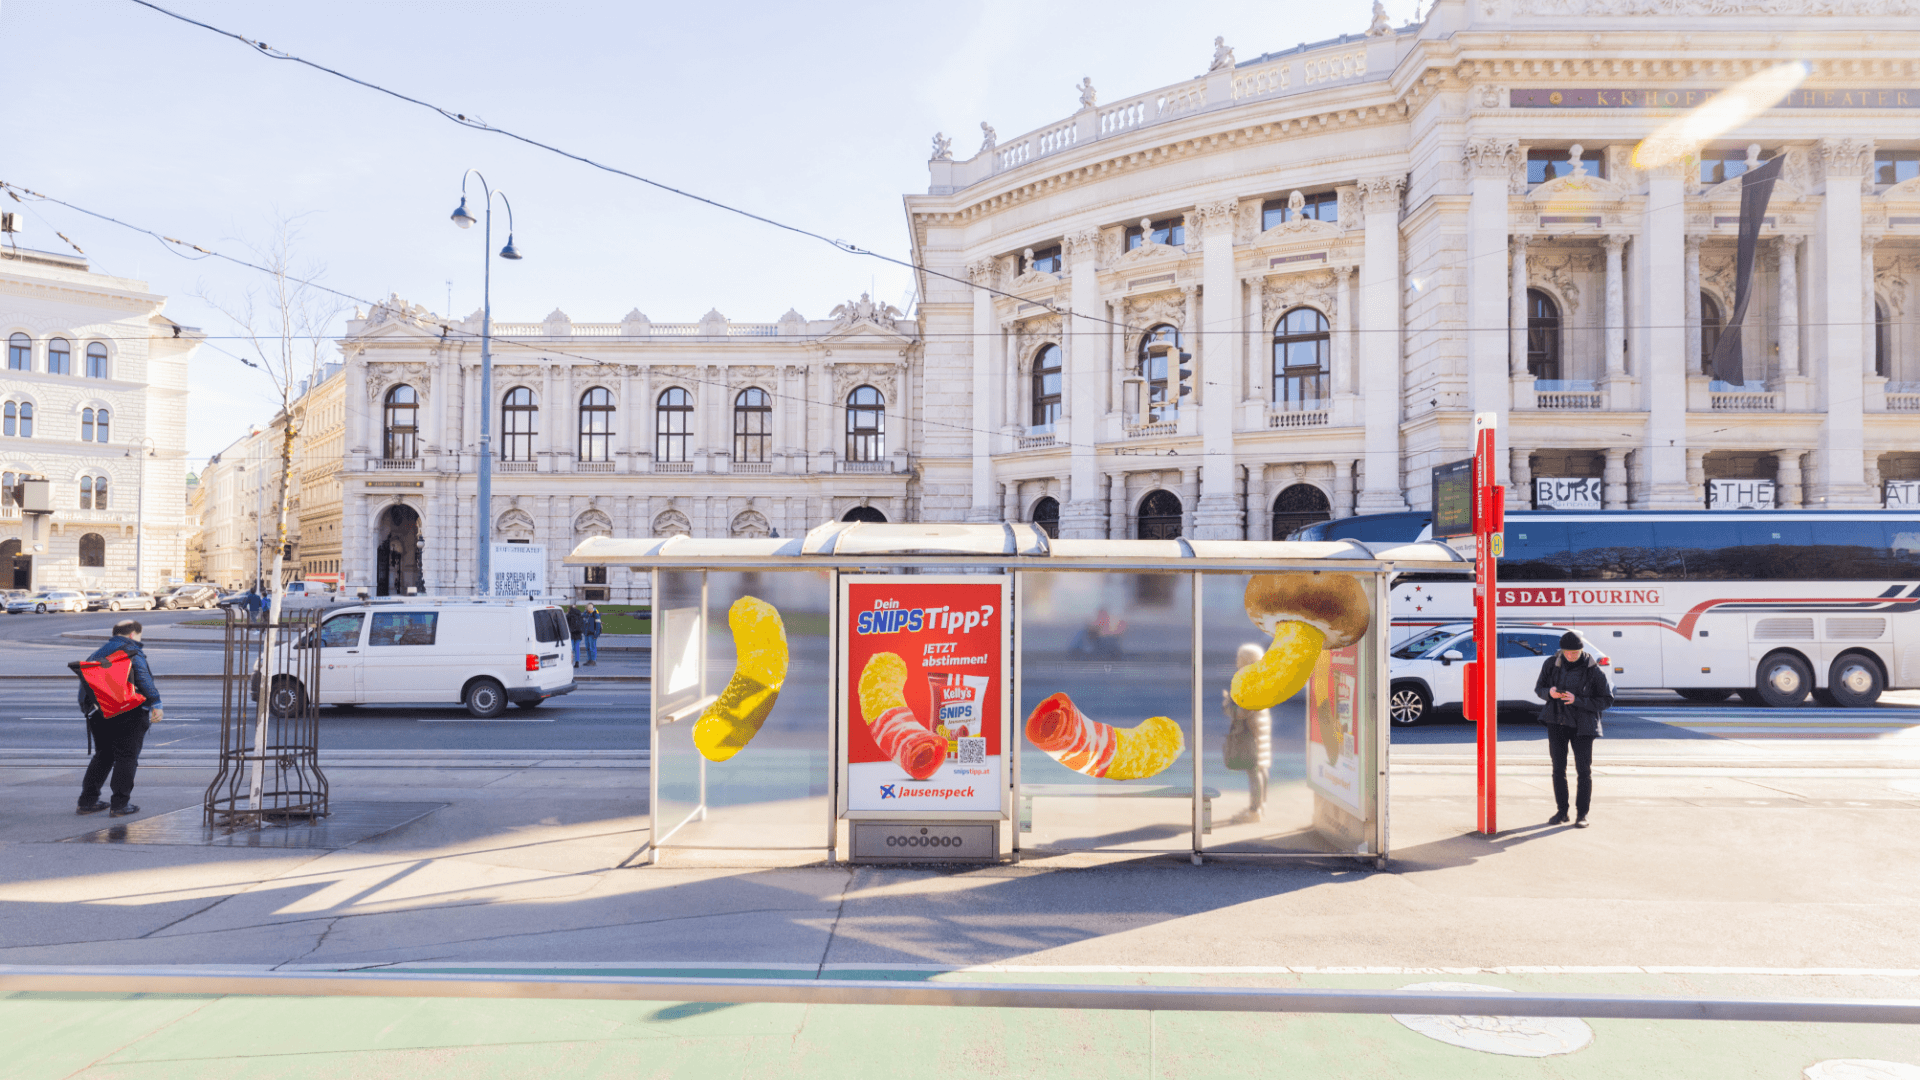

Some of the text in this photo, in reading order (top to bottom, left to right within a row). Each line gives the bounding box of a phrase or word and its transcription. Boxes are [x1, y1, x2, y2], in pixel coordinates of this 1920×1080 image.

[1493, 539, 1500, 552] H
[527, 570, 536, 581] FÜR
[495, 581, 503, 589] SIE
[504, 581, 520, 589] HEUTE
[1568, 589, 1660, 604] TOURING
[874, 598, 899, 610] Dein
[857, 608, 924, 636] SNIPS
[923, 642, 958, 656] JETZT
[922, 654, 988, 668] abstimmen!
[943, 687, 972, 700] Kelly's
[939, 705, 973, 720] SNIPS
[953, 768, 990, 776] snipstipp.at
[898, 786, 975, 800] Jausenspeck
